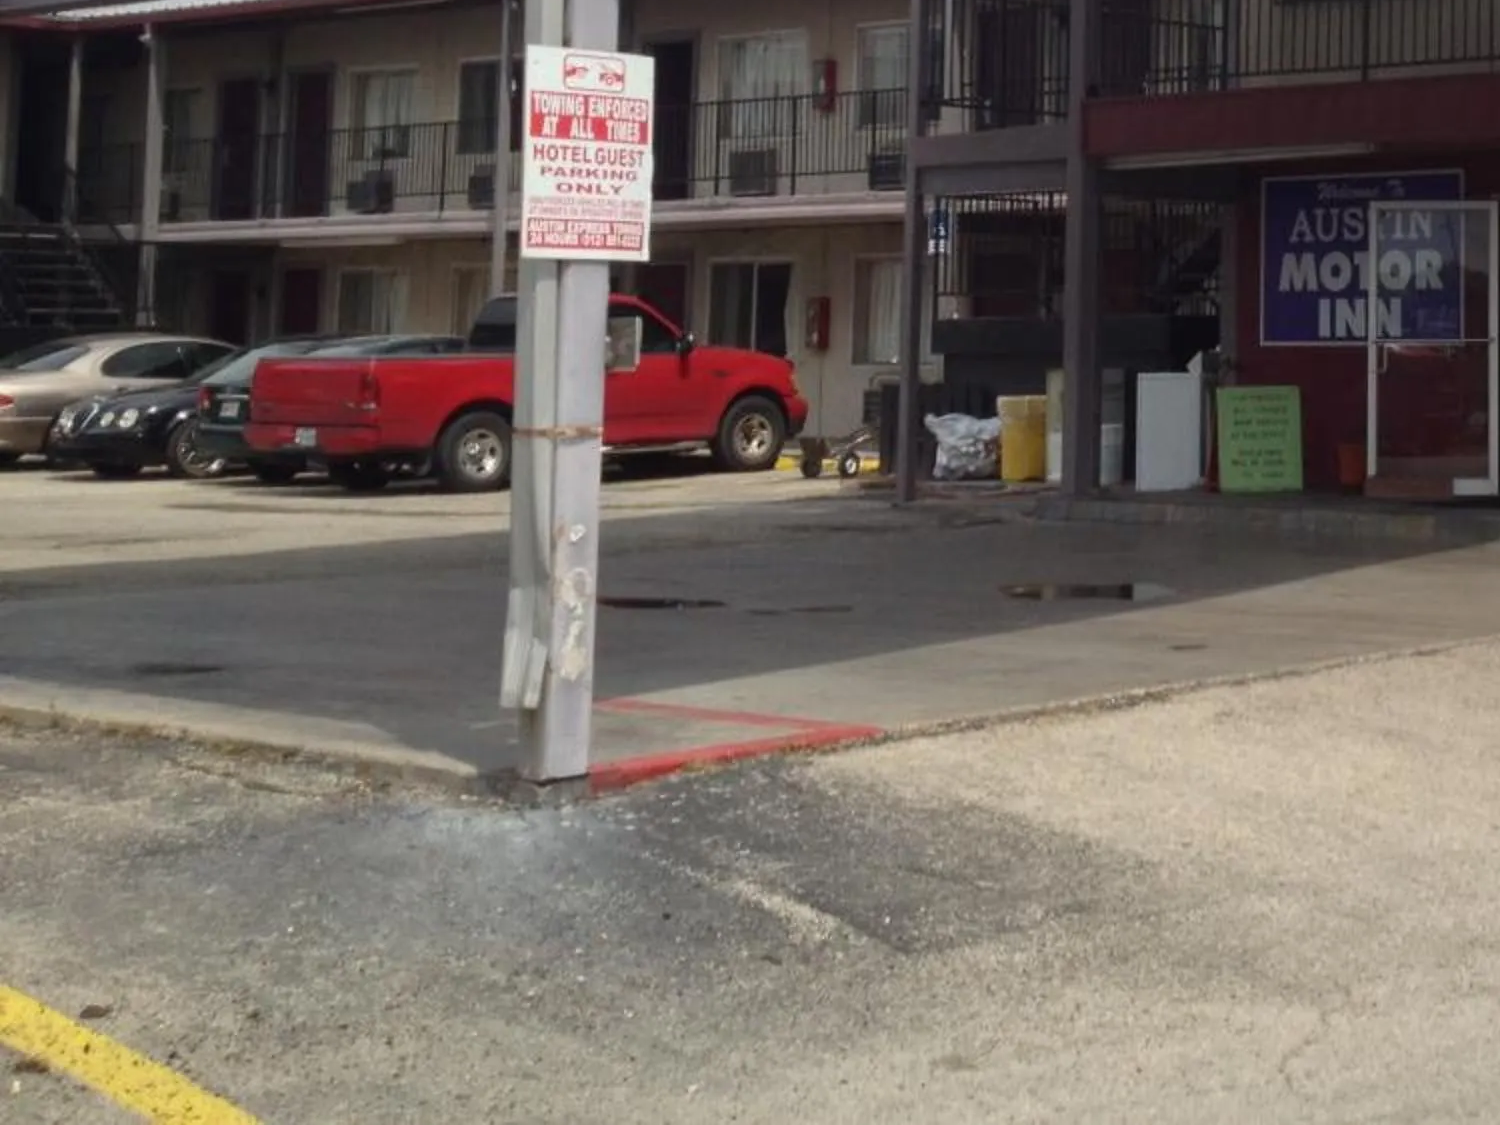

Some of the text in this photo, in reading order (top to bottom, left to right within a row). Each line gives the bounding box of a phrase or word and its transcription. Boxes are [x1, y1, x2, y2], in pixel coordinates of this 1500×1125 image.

[533, 93, 647, 122] TOWING ENFORCED
[541, 115, 640, 143] AT ALL TIMES
[533, 143, 645, 169] HOTEL GUEST
[540, 166, 638, 181] PARKING
[556, 183, 625, 196] ONLY
[1288, 208, 1433, 244] AUSIN
[1317, 297, 1402, 339] INN
